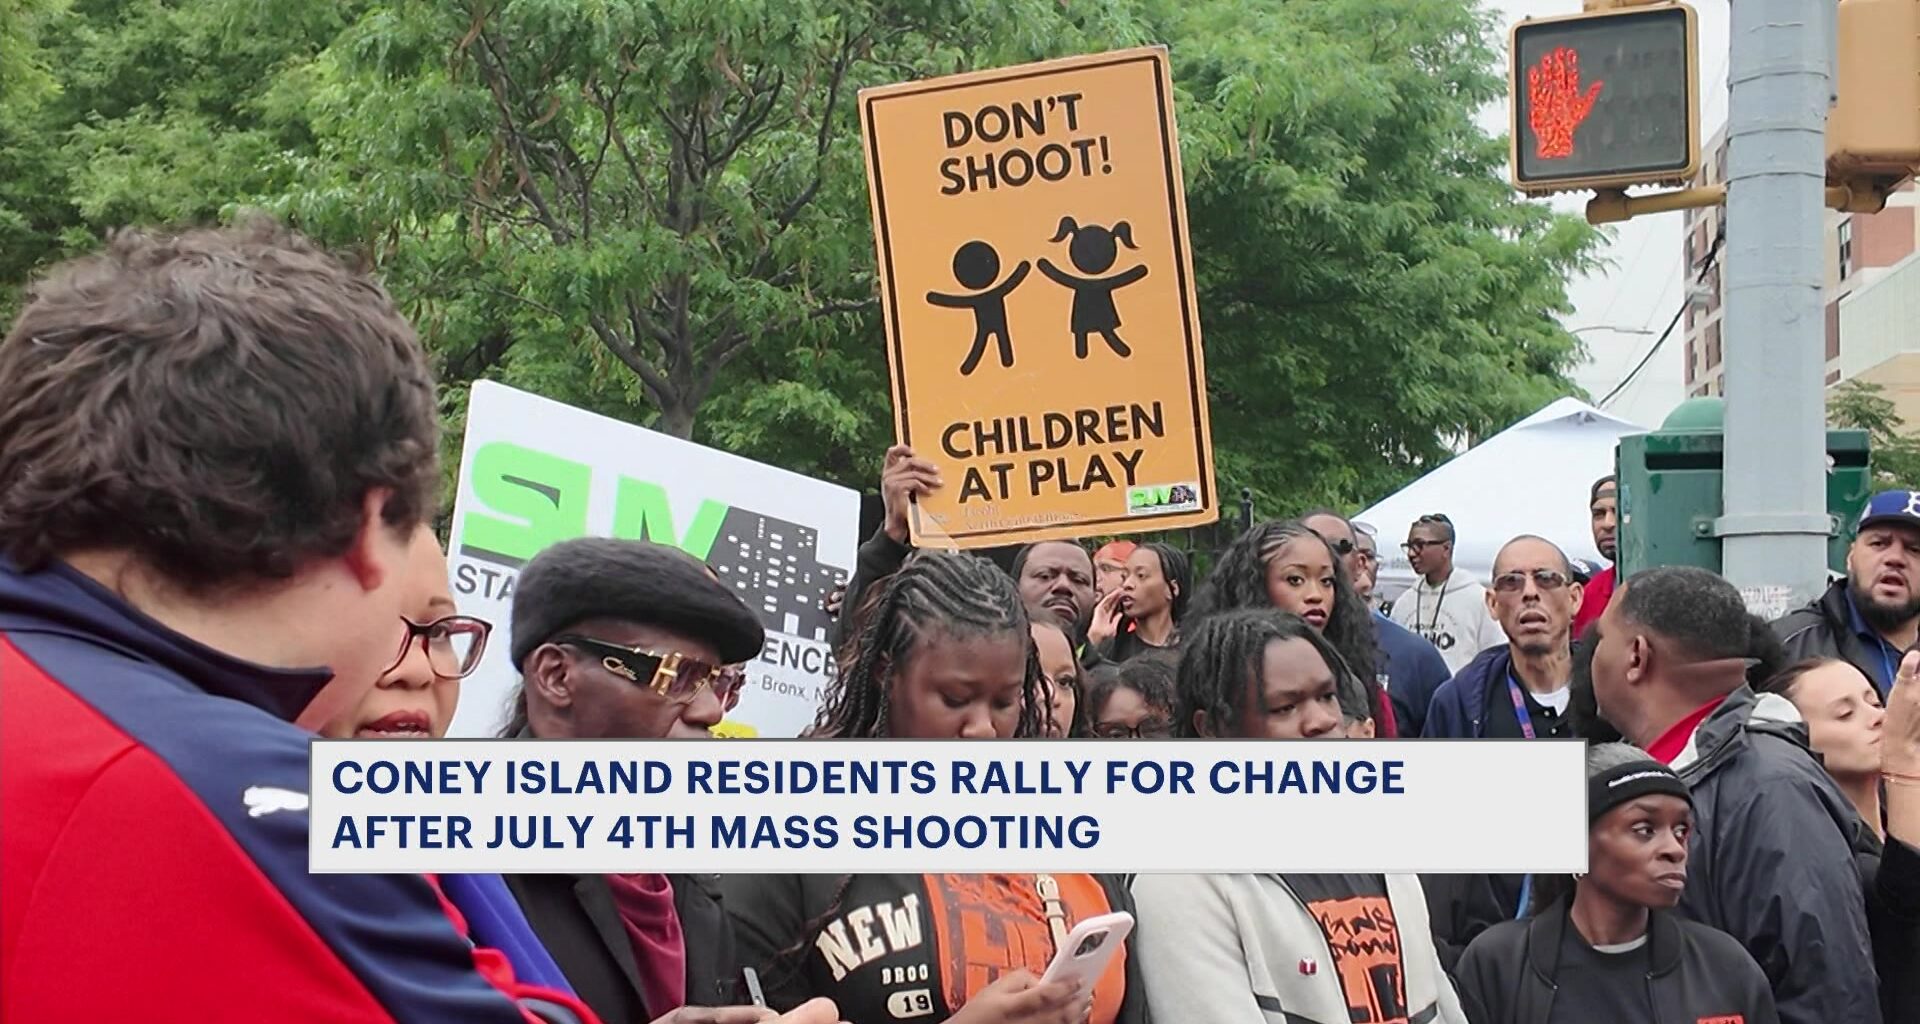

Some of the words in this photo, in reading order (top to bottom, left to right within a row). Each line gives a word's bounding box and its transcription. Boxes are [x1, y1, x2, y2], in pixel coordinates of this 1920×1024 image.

[943, 93, 1083, 150] DON'T
[940, 136, 1113, 196] SHOOT!
[940, 401, 1165, 460] CHILDREN
[958, 462, 1016, 504] AT
[1028, 449, 1145, 498] PLAY
[815, 892, 923, 982] NEW
